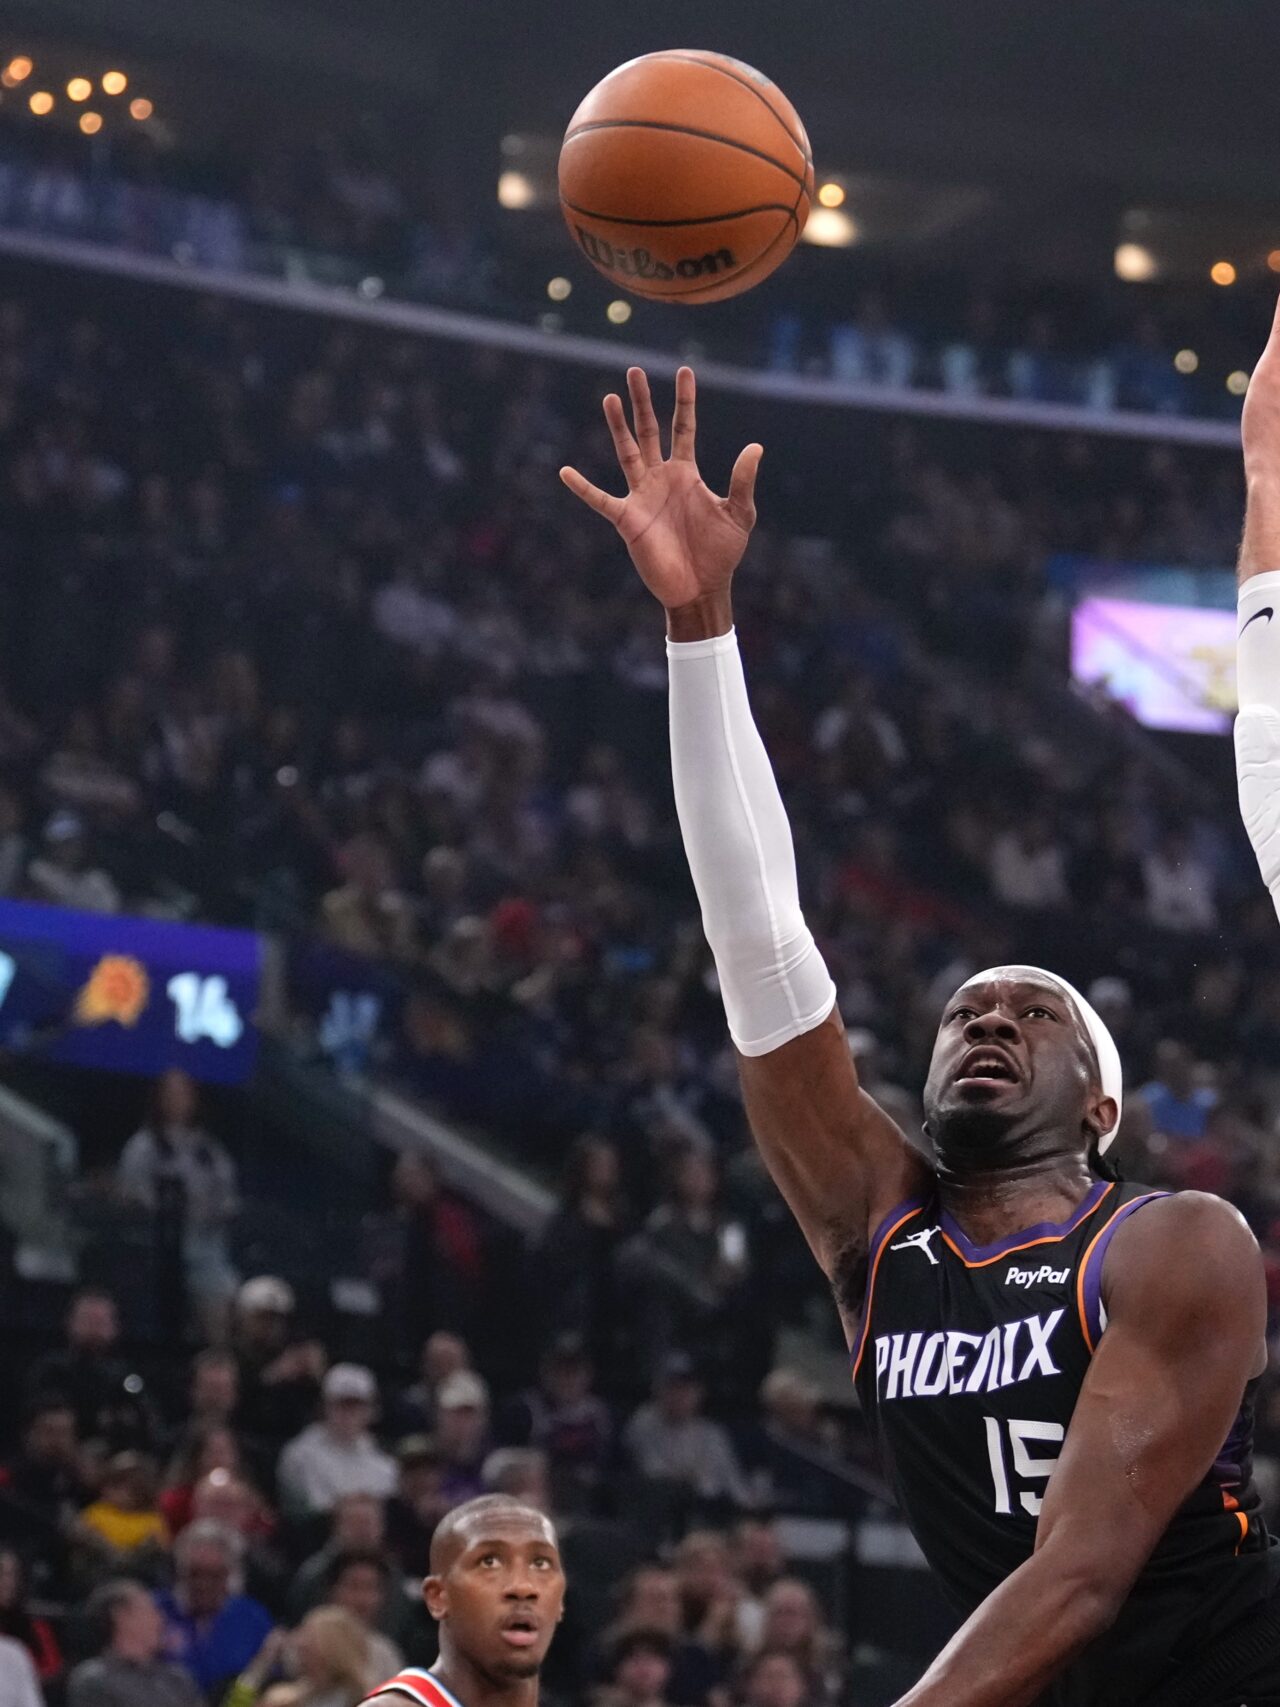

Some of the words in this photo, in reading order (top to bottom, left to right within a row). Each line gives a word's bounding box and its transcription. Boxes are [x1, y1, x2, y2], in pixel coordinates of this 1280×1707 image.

[574, 224, 736, 281] Wilson
[1005, 1265, 1070, 1289] PayPal
[875, 1308, 1066, 1402] PHOENIX
[982, 1416, 1064, 1517] 15
